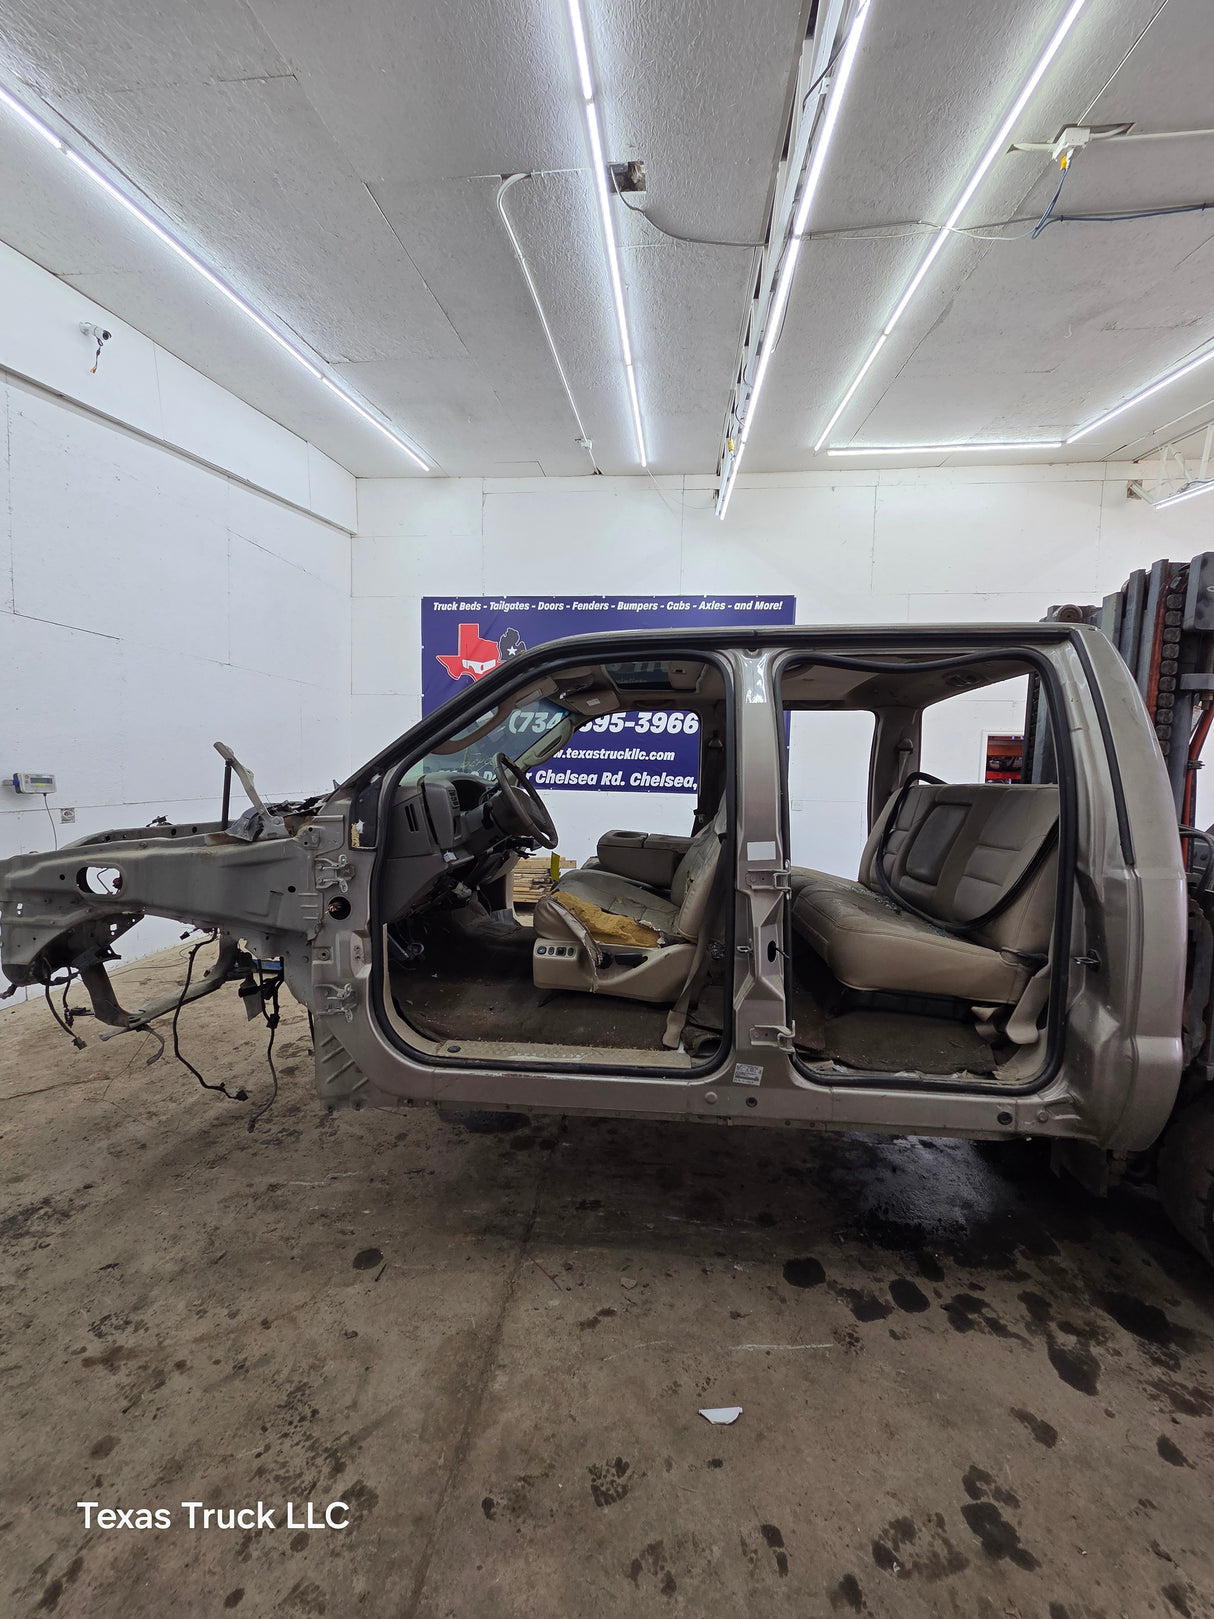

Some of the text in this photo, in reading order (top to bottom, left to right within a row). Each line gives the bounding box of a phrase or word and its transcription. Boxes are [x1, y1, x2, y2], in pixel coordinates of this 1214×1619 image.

[433, 602, 458, 611] Truck
[459, 602, 482, 611] Beds
[489, 601, 530, 612] Tailgates
[538, 602, 565, 611] Doors
[572, 602, 610, 611] Fenders
[617, 601, 659, 612] Bumpers
[666, 601, 691, 610] Cabs
[698, 601, 726, 610] Axles
[734, 601, 752, 610] and
[754, 600, 783, 610] More!
[508, 709, 569, 734] (734
[553, 748, 675, 760] w.texastruckllc.com
[535, 769, 598, 785] Chelsea
[601, 771, 625, 786] Rd.
[630, 772, 698, 790] Chelsea,
